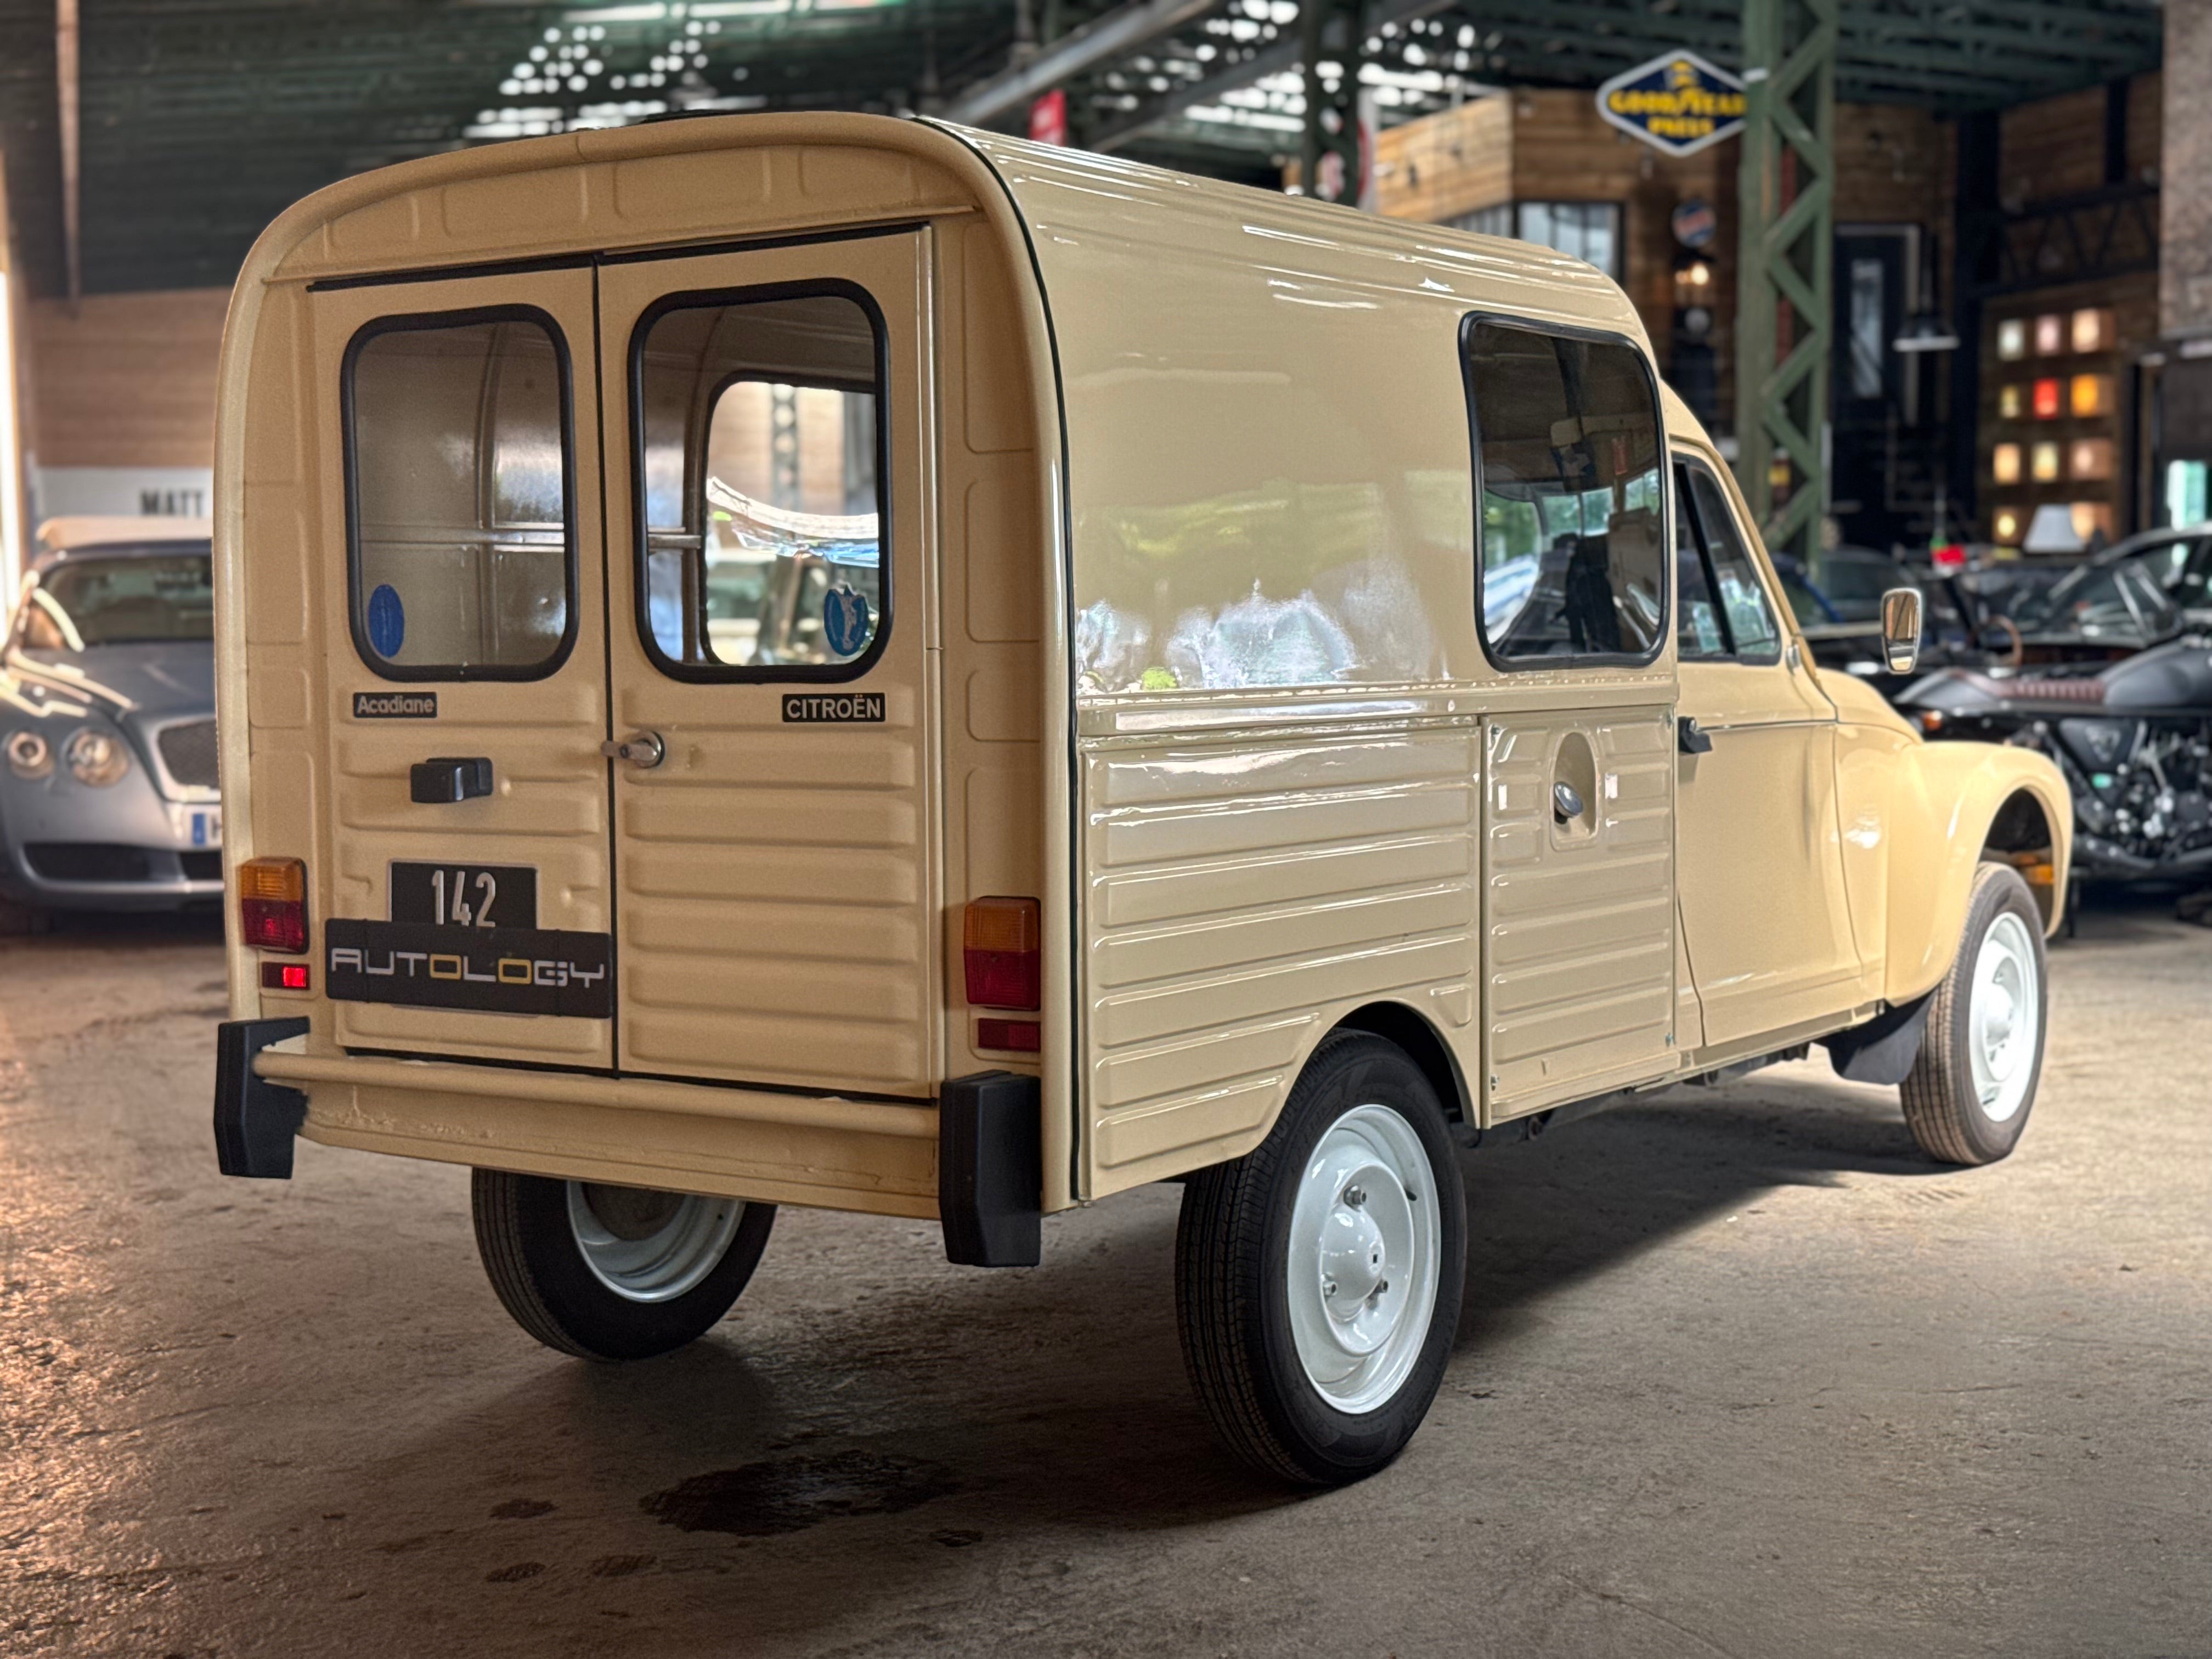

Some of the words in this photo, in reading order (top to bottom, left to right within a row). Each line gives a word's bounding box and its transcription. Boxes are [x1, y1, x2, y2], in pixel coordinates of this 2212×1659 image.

[357, 695, 435, 714] Acadiane
[786, 694, 881, 719] CITROËN
[431, 869, 496, 928] 142
[331, 947, 605, 988] AUTOLOGY
